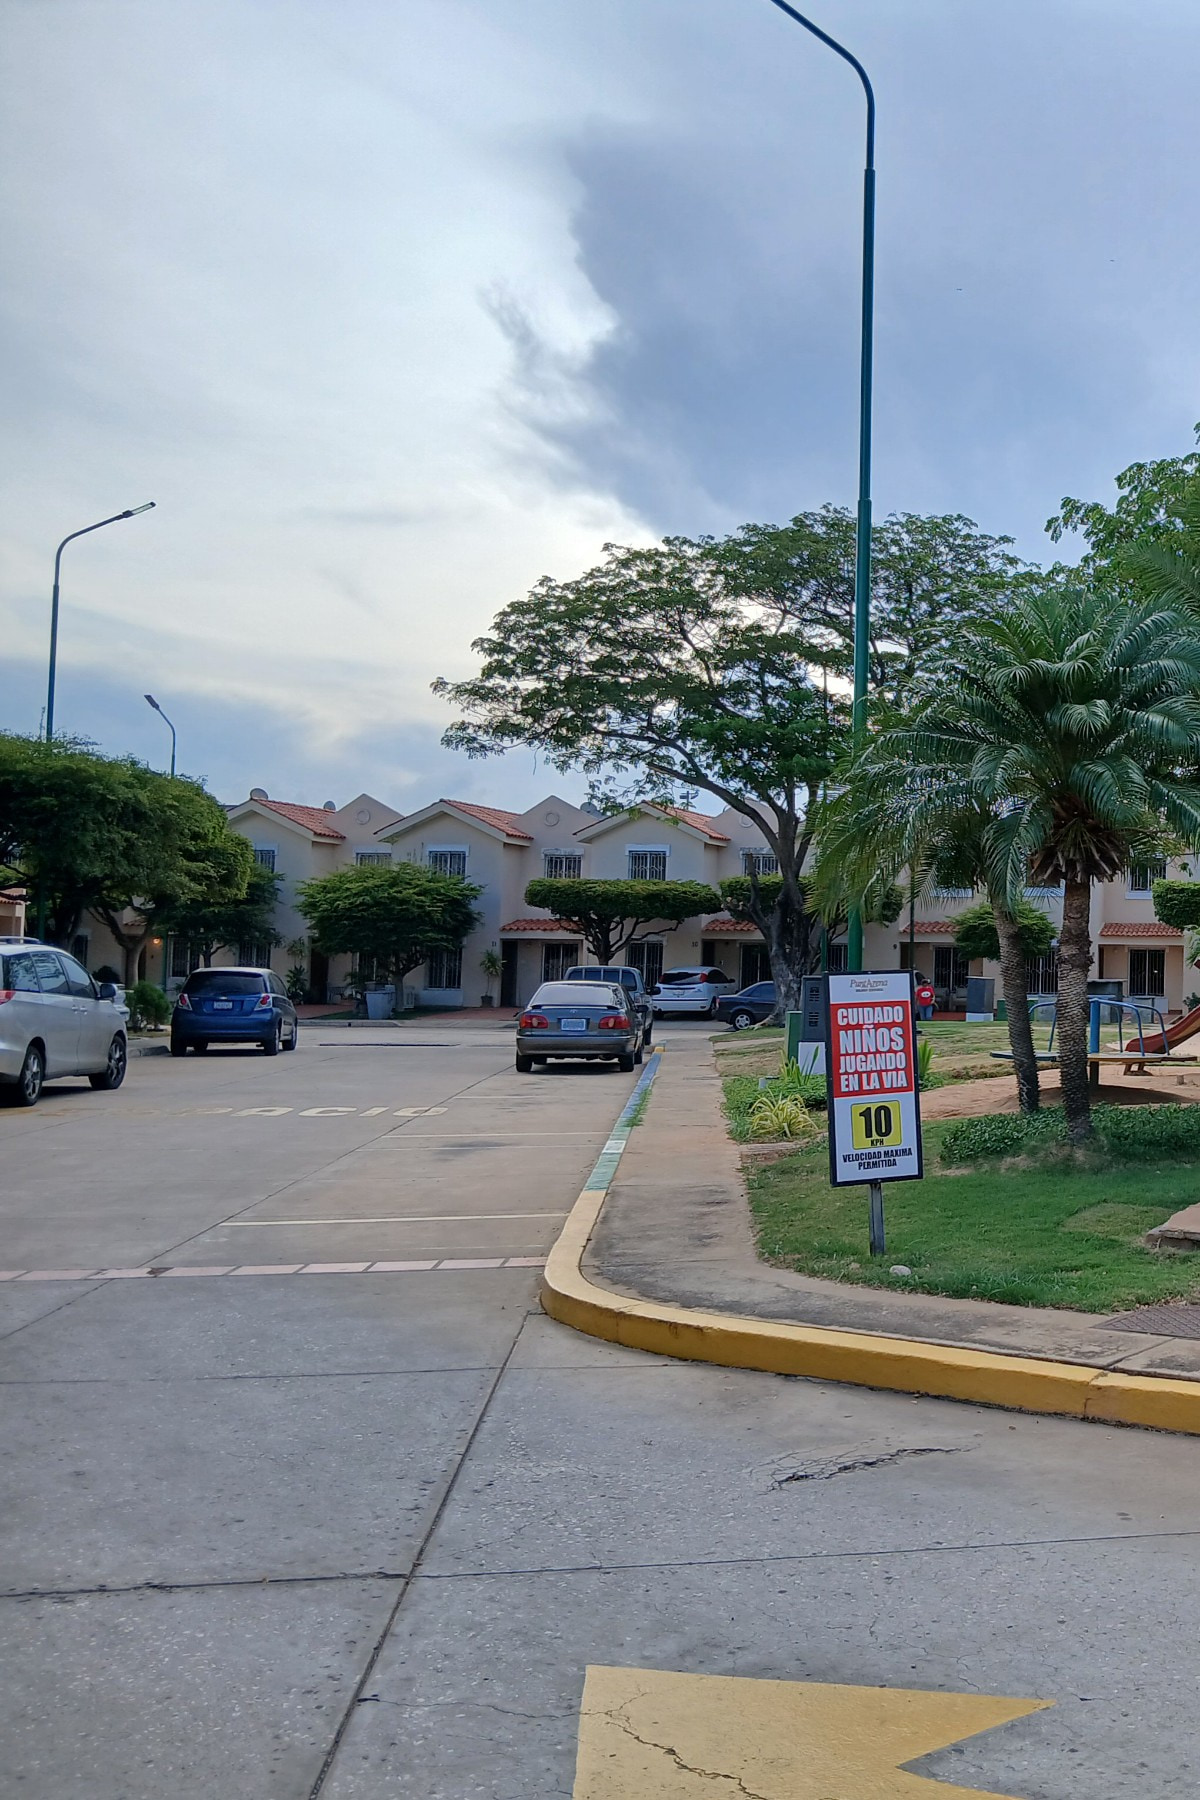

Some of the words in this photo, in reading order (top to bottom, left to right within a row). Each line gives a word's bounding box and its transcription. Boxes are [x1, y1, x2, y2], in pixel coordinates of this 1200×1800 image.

[837, 1006, 903, 1025] CUIDADO
[839, 1024, 904, 1054] NIÑOS
[839, 1052, 906, 1073] JUGANDO
[840, 1073, 859, 1092] EN
[862, 1072, 880, 1090] LA
[882, 1070, 908, 1088] VIA
[859, 1105, 892, 1138] 10
[842, 1151, 882, 1163] VELOCIDAD
[883, 1147, 912, 1158] MAXIMA
[858, 1158, 897, 1170] PERMITIDA
